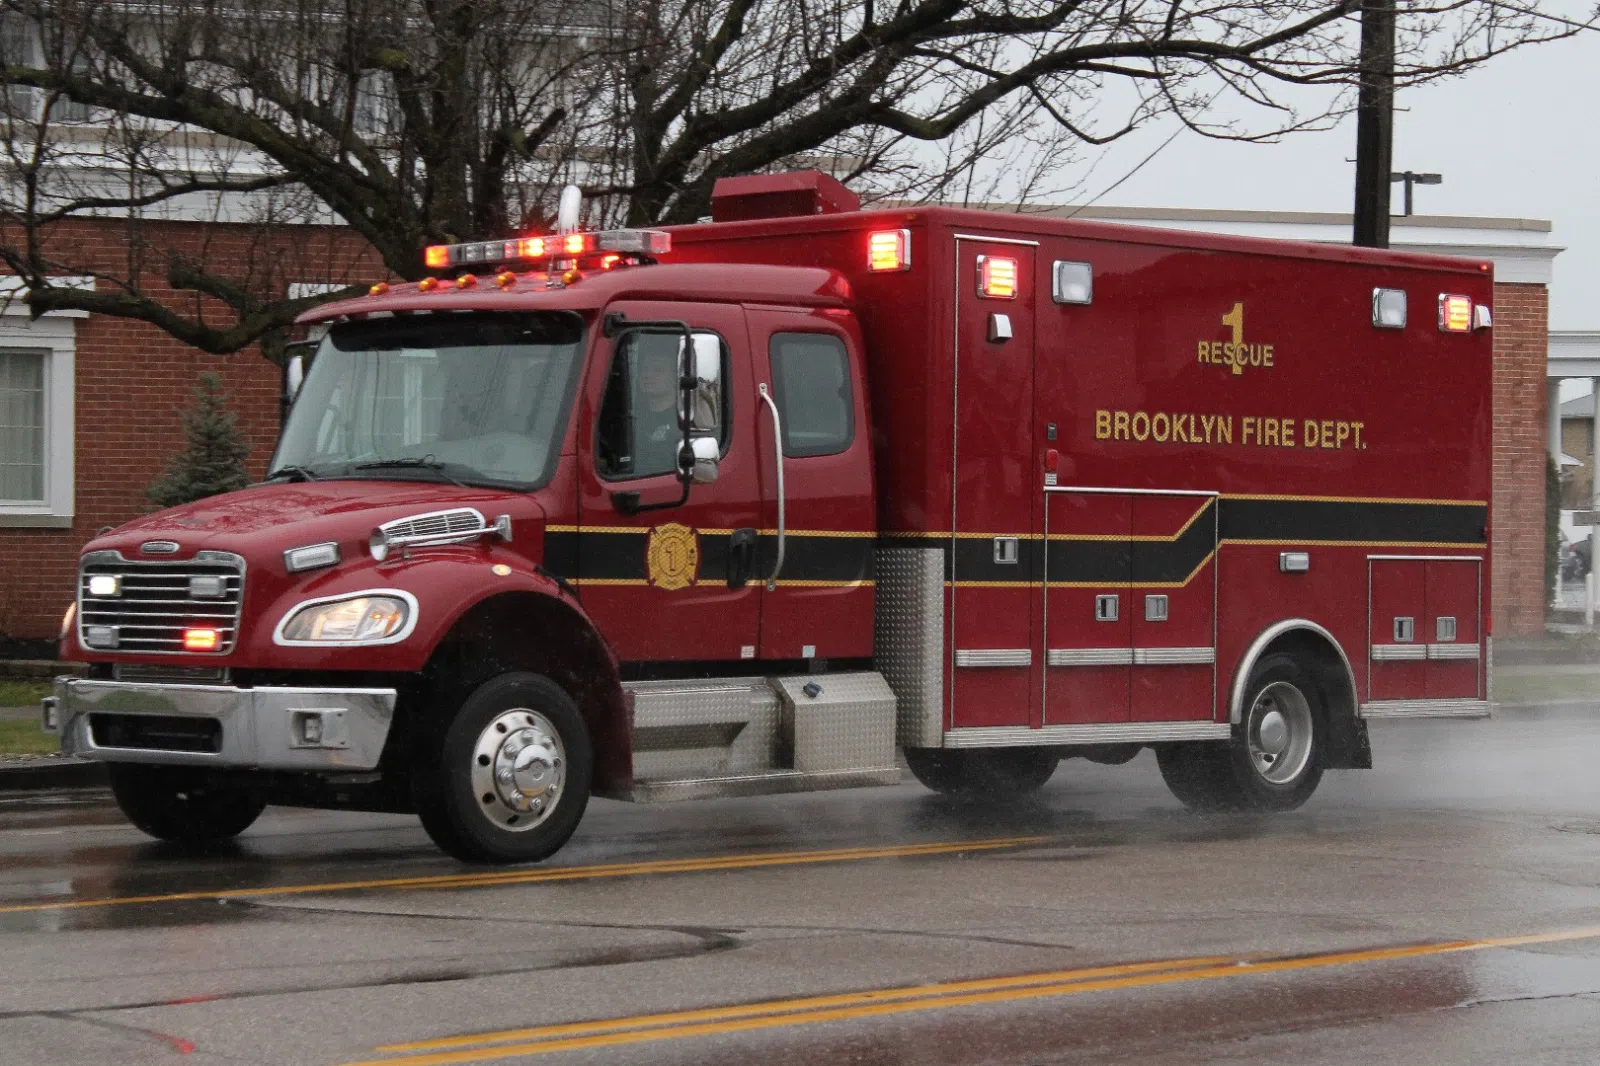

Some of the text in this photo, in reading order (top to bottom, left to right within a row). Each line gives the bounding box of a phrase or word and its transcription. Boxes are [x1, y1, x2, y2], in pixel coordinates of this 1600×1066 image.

[1197, 341, 1274, 367] RESCUE
[1222, 302, 1243, 375] 1
[1095, 410, 1367, 449] BROOKLYN FIRE DEPT.
